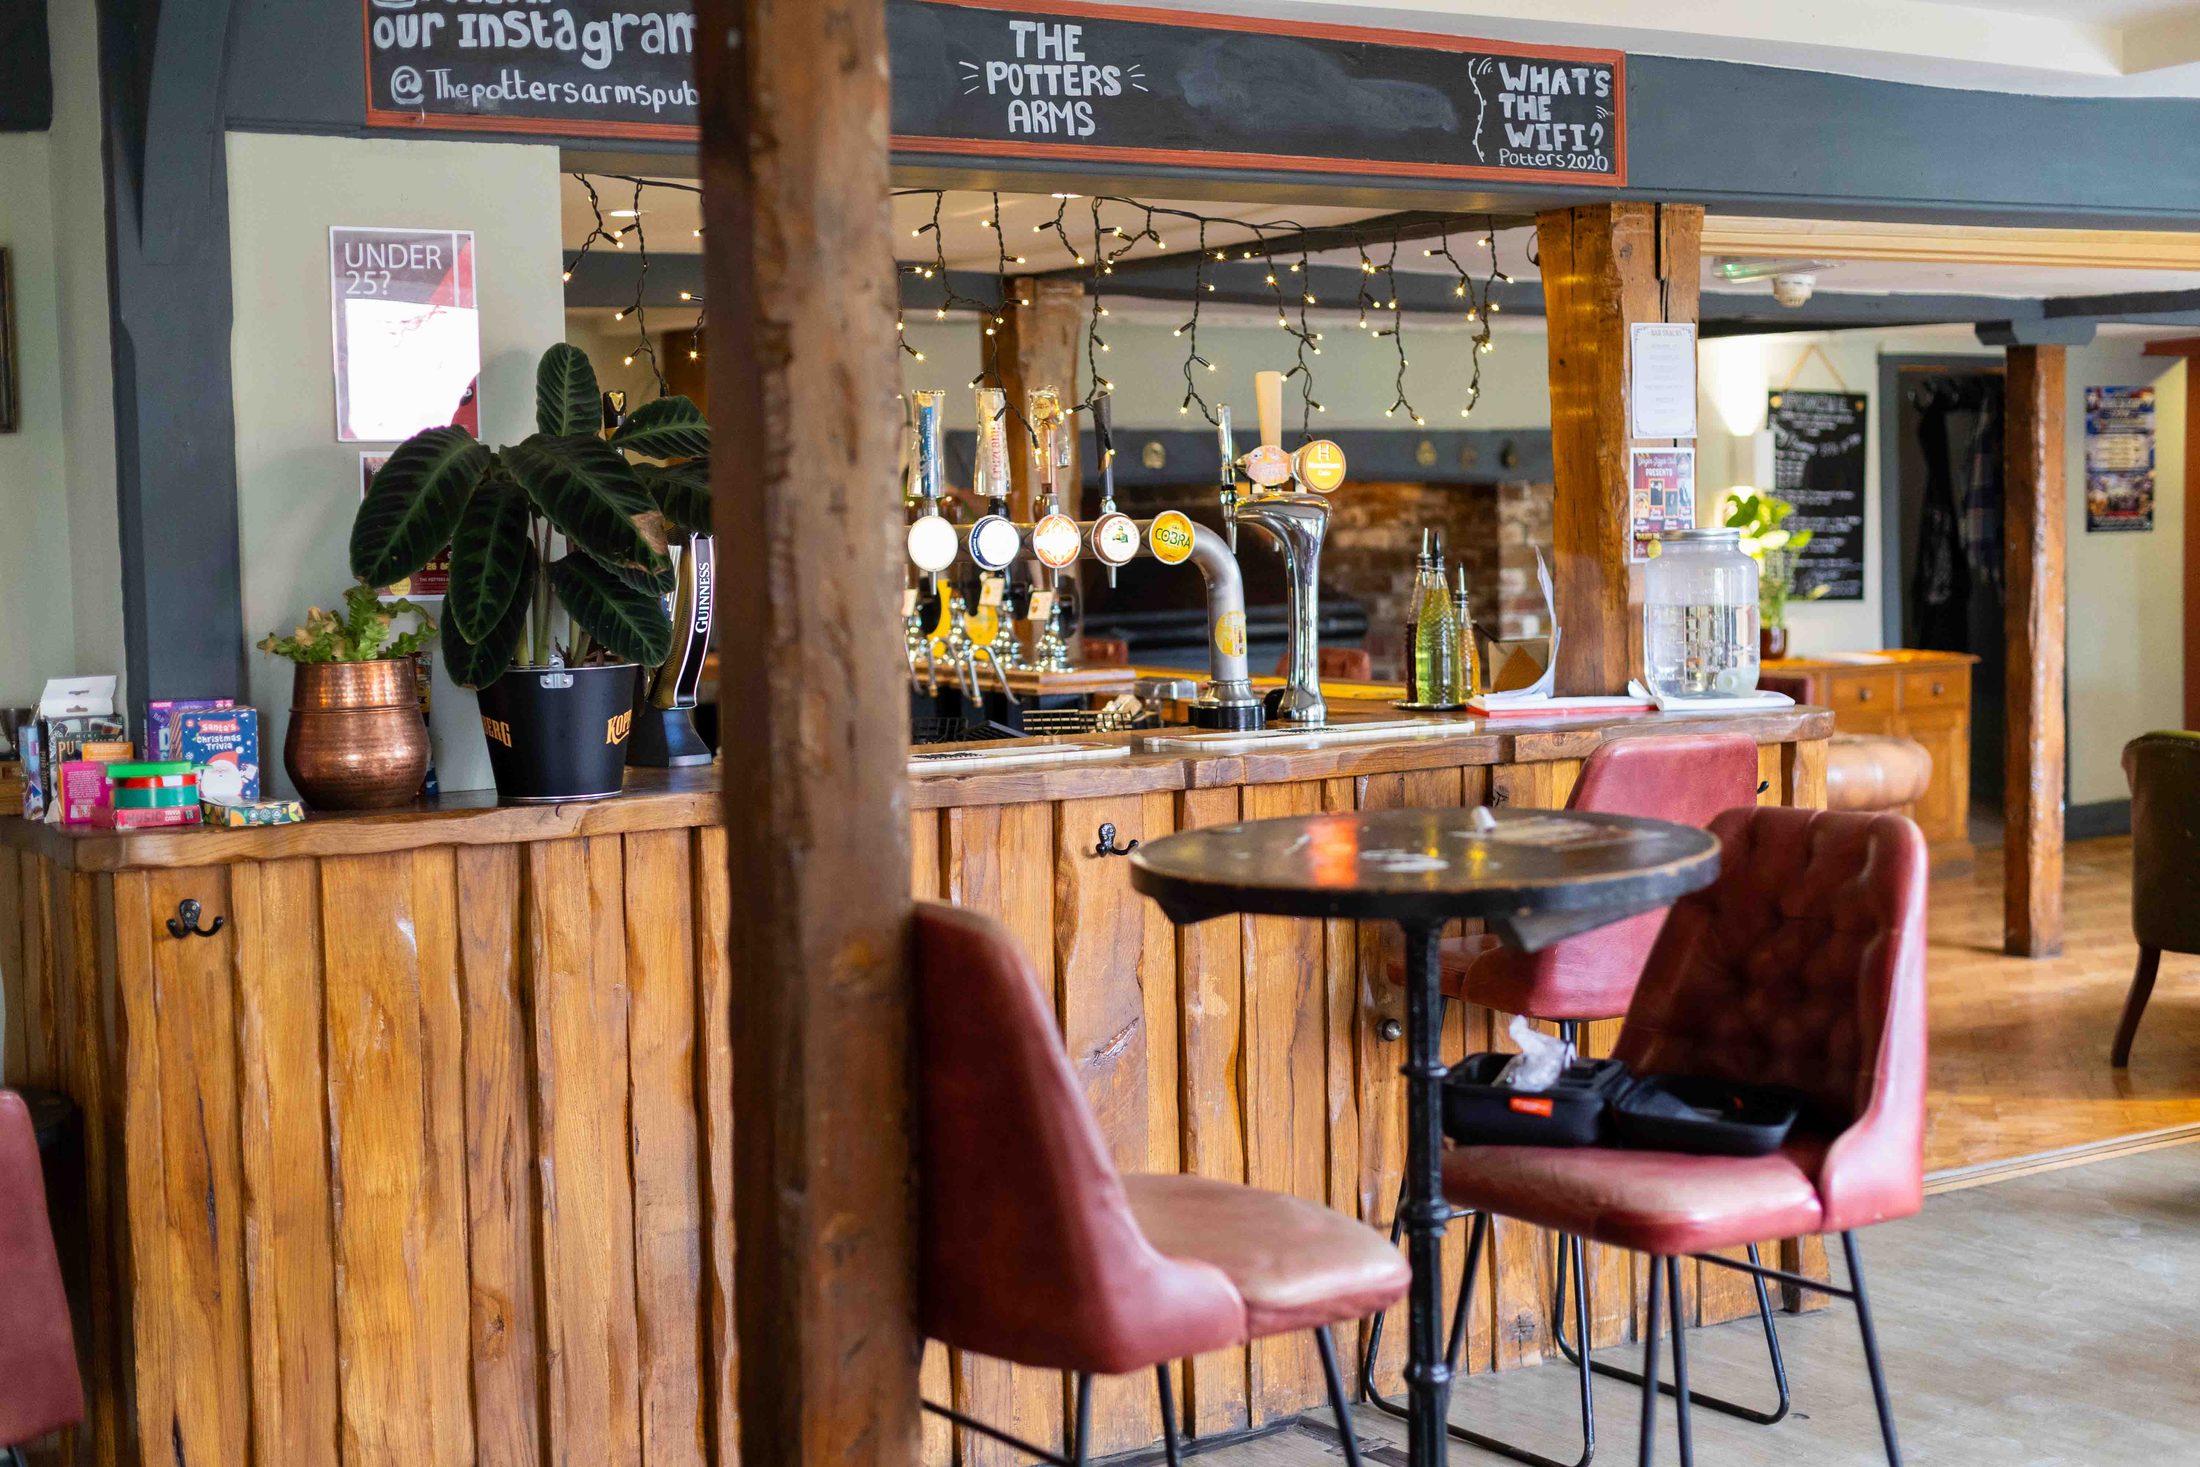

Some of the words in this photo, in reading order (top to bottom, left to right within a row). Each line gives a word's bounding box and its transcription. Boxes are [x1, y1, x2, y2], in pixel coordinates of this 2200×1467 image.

[373, 12, 445, 49] our
[1009, 20, 1086, 62] THE
[986, 61, 1122, 97] POTTERS
[1499, 62, 1611, 98] WHAT'S
[1008, 99, 1096, 137] ARMS
[1498, 93, 1551, 121] THE
[1504, 122, 1605, 156] WIFI?
[1499, 148, 1609, 172] Potters2020
[344, 242, 442, 270] UNDER
[345, 271, 391, 295] 25?
[1155, 527, 1191, 550] COBRA
[695, 562, 710, 633] GUINNESS
[58, 741, 82, 762] PU
